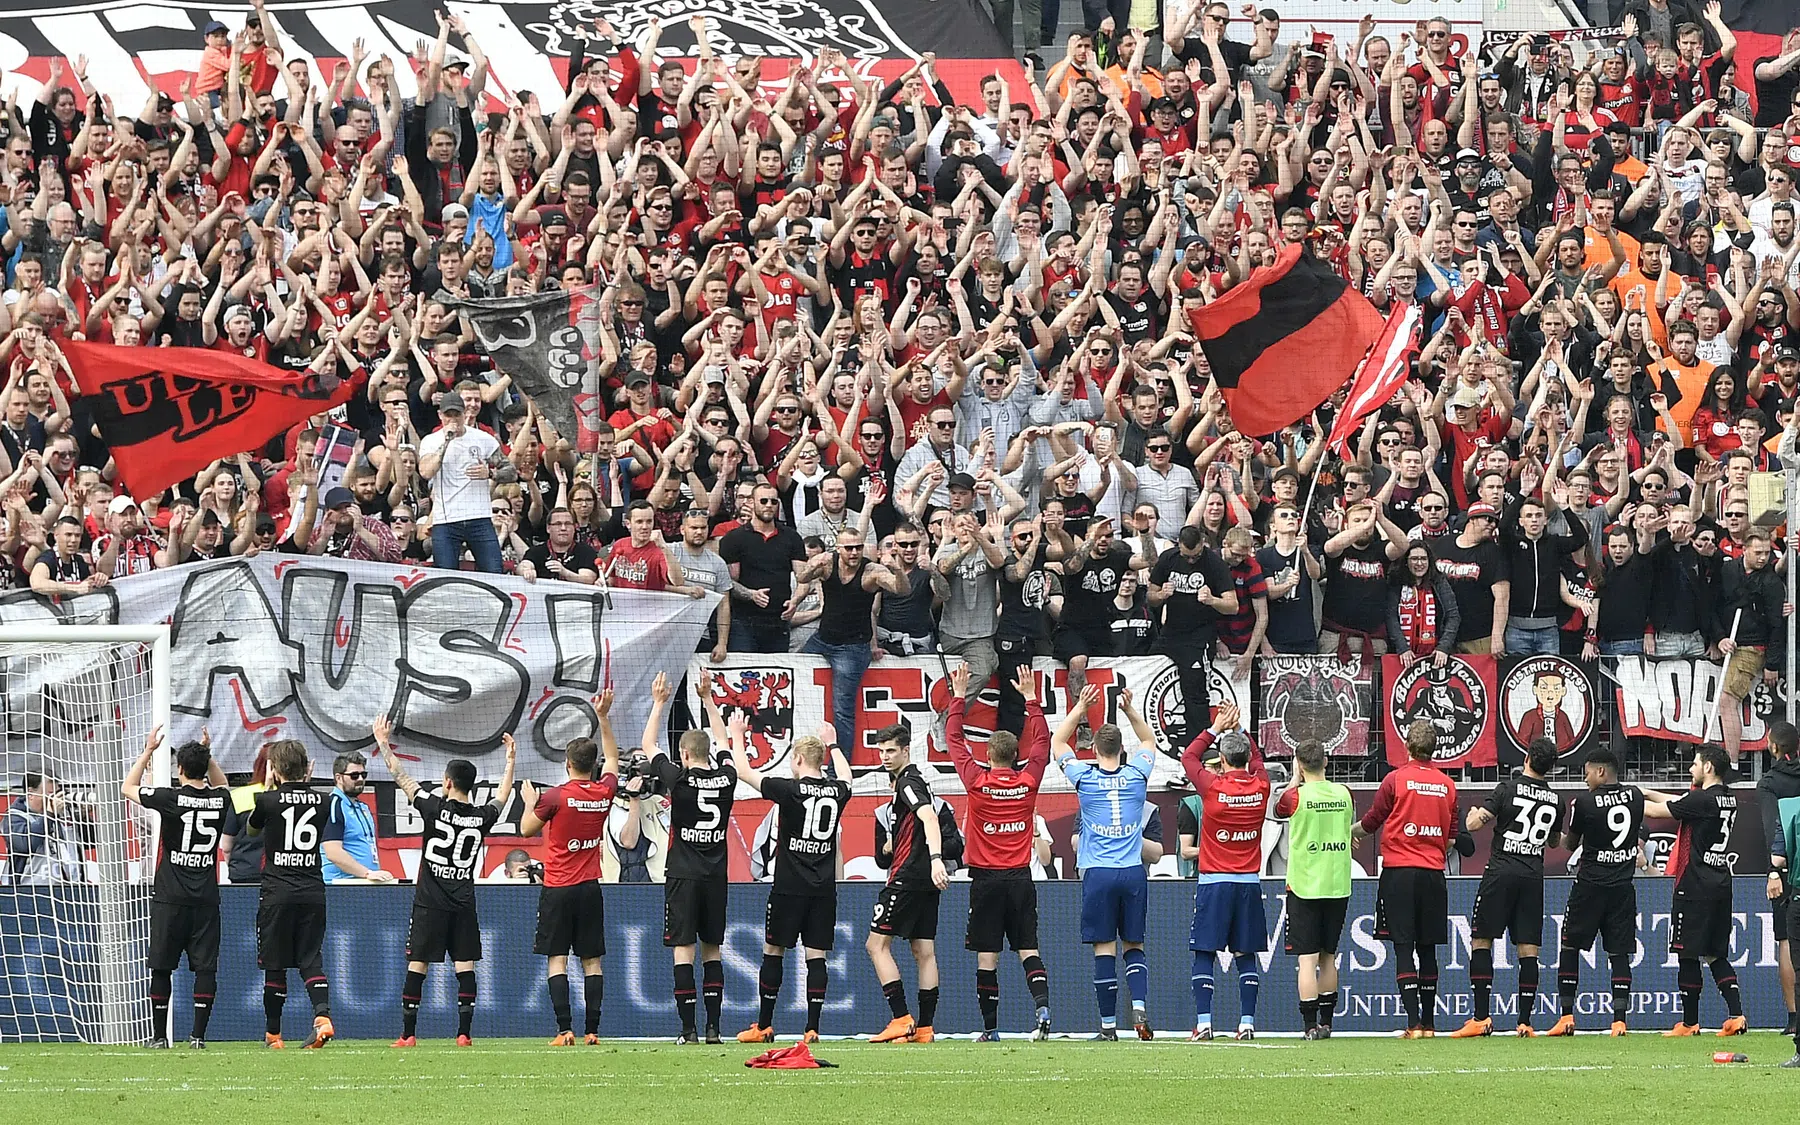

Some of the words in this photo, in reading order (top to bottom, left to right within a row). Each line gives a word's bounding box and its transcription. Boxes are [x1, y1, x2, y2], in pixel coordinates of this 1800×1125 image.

[775, 294, 792, 305] LG
[170, 561, 602, 763] AUS!
[1507, 660, 1557, 691] DISTRICT
[1557, 665, 1588, 694] 42799
[981, 785, 1029, 797] Barmenia
[1406, 779, 1448, 794] Barmenia
[278, 792, 322, 805] JEDVAJ
[1218, 792, 1263, 804] Barmenia
[1306, 799, 1347, 810] Barmenia
[1594, 788, 1634, 808] BAILEY
[694, 790, 721, 830] 5
[1105, 789, 1121, 825] 1
[801, 797, 839, 840] 10
[1503, 796, 1557, 846] 38
[180, 810, 220, 854] 15
[281, 806, 318, 851] 16
[997, 821, 1026, 833] JAKO
[1418, 825, 1443, 837] JAKO
[1606, 805, 1632, 849] 9
[681, 828, 712, 843] BAYER
[1231, 829, 1258, 842] JAKO
[424, 819, 482, 869] 20
[789, 837, 820, 854] BAYER
[1321, 841, 1347, 852] JAKO
[1503, 838, 1531, 856] BAYER
[170, 850, 201, 867] BAYER
[202, 852, 215, 868] 04
[273, 851, 304, 867] BAYER
[1596, 850, 1625, 863] BAYER
[456, 867, 471, 880] 04
